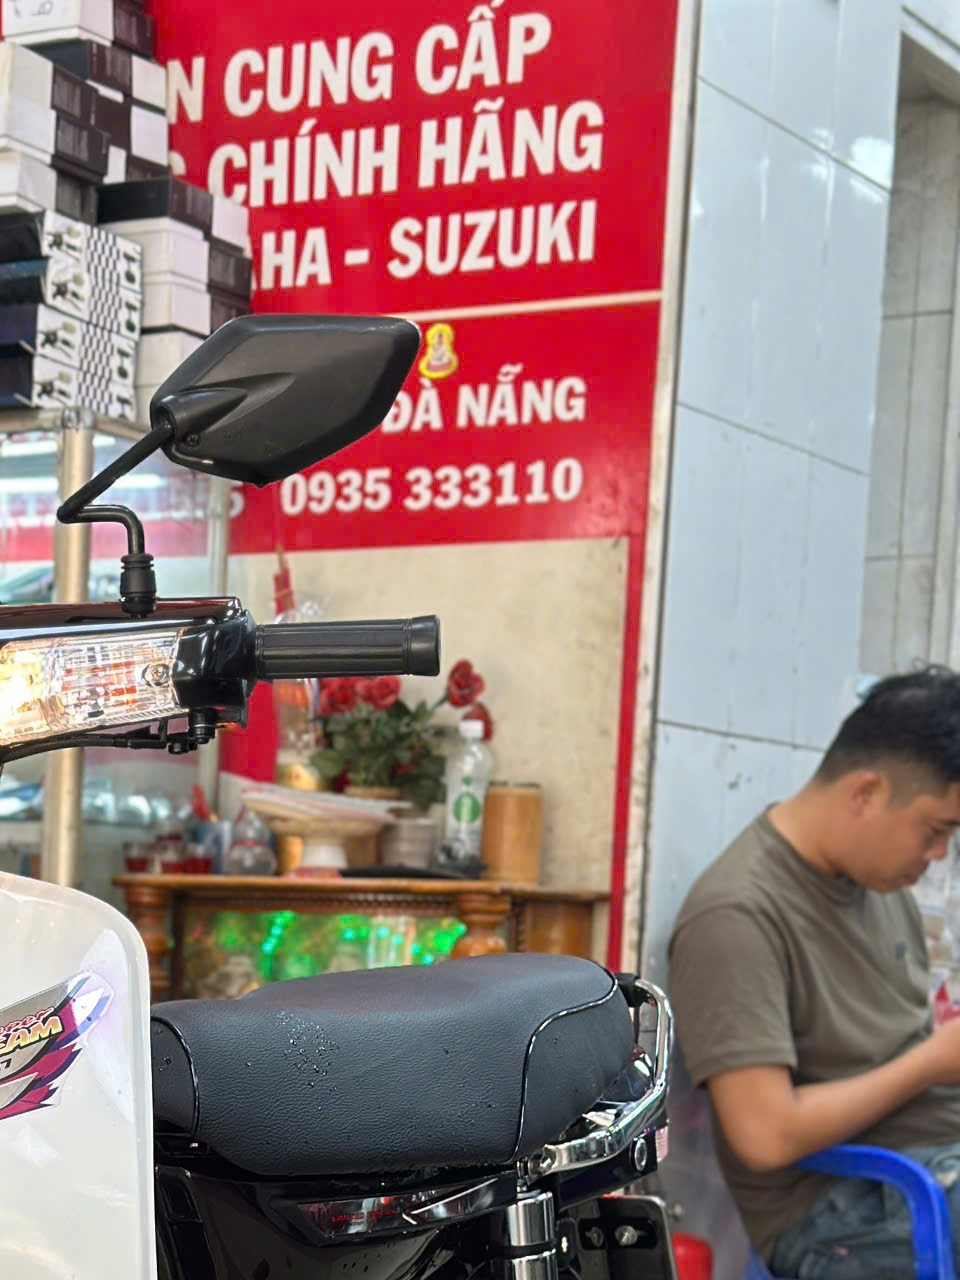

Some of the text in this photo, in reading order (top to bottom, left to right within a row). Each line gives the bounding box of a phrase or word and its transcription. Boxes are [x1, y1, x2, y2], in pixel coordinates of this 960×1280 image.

[223, 31, 394, 118] CUNG
[415, 0, 551, 95] CẤP
[207, 97, 604, 210] CHÍNH HÃNG
[249, 227, 332, 291] HA
[387, 199, 597, 279] SUZUKI
[456, 362, 586, 430] NẴNG
[280, 467, 393, 515] 0935
[404, 457, 584, 511] 333110
